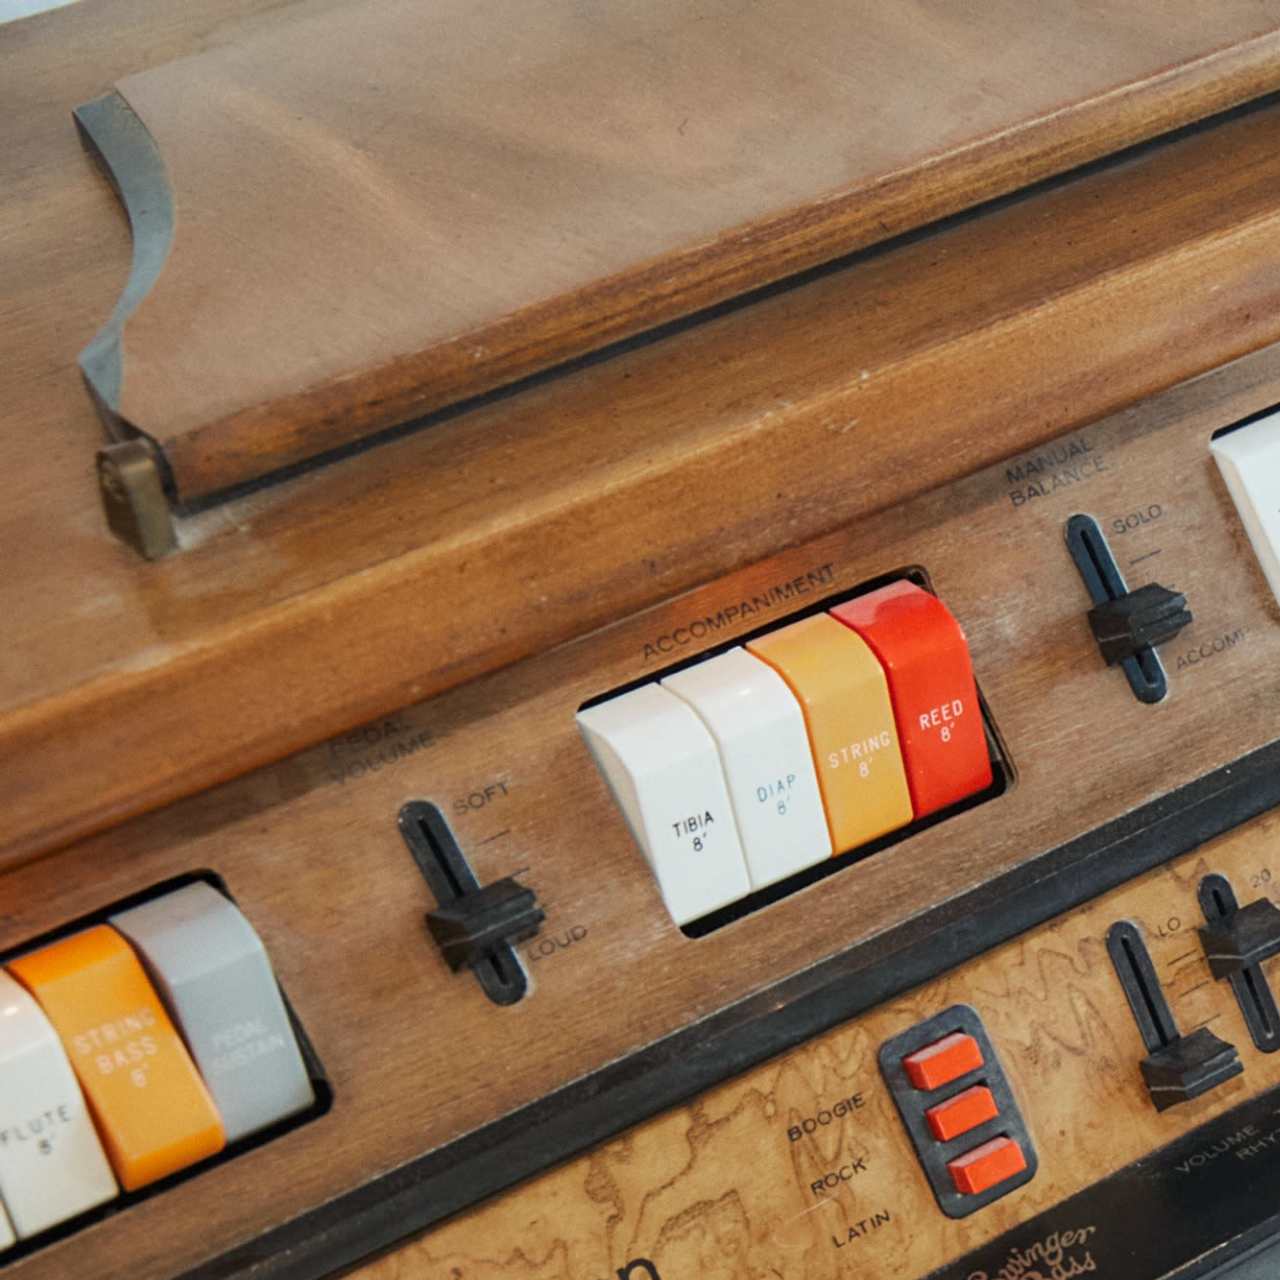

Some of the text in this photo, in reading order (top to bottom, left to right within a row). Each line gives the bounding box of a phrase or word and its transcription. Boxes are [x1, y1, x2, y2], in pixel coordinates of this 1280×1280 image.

[1004, 437, 1093, 485] MANUAL
[1008, 455, 1107, 508] BALANCE
[1112, 503, 1163, 535] SOLO
[641, 562, 838, 661] ACCOMPANIMENT
[918, 699, 964, 731] REED
[827, 730, 892, 770] STRING
[452, 777, 512, 817] SOFT
[756, 773, 797, 803] DIAP
[671, 809, 716, 839] TIBIA
[527, 923, 589, 964] LOUD
[1157, 916, 1182, 938] LO
[72, 1009, 156, 1055] STRING
[96, 1035, 158, 1076] BASS
[0, 1104, 71, 1147] FLUTE
[786, 1092, 867, 1144] BOOGIE
[1174, 1124, 1260, 1175] VOLUME
[810, 1156, 870, 1196] ROCK
[831, 1208, 892, 1249] LATIN
